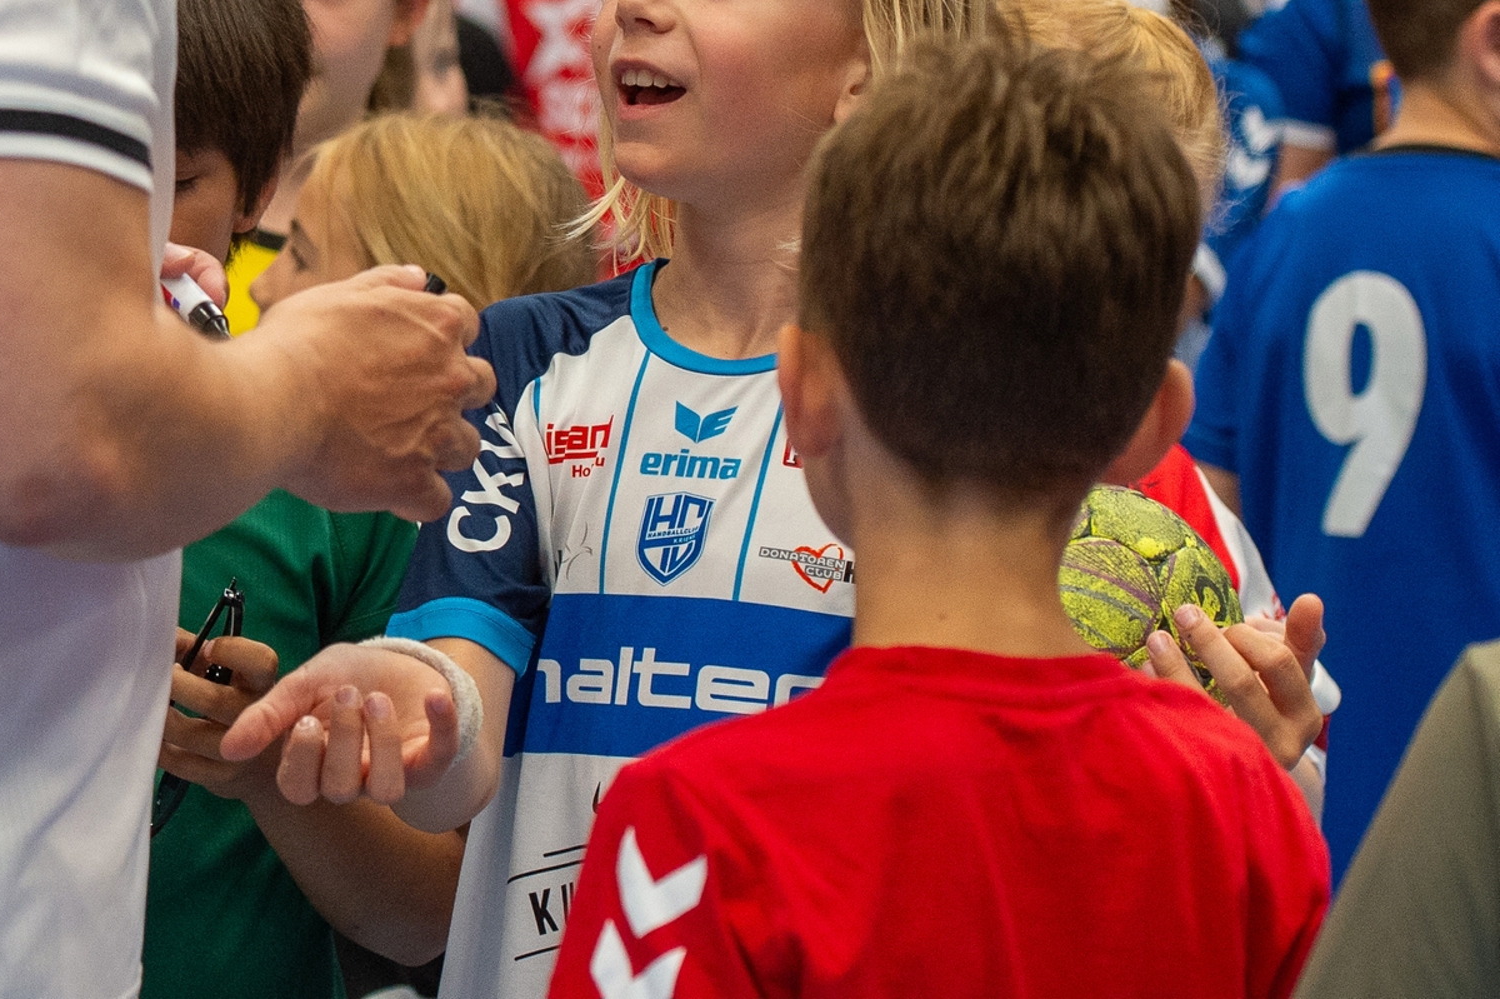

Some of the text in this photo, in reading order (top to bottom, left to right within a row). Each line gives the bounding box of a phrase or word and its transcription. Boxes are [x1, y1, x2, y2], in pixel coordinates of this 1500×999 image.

[1303, 269, 1429, 539] 9
[546, 415, 614, 455] isan
[639, 449, 742, 480] erima
[805, 566, 843, 581] CLUB
